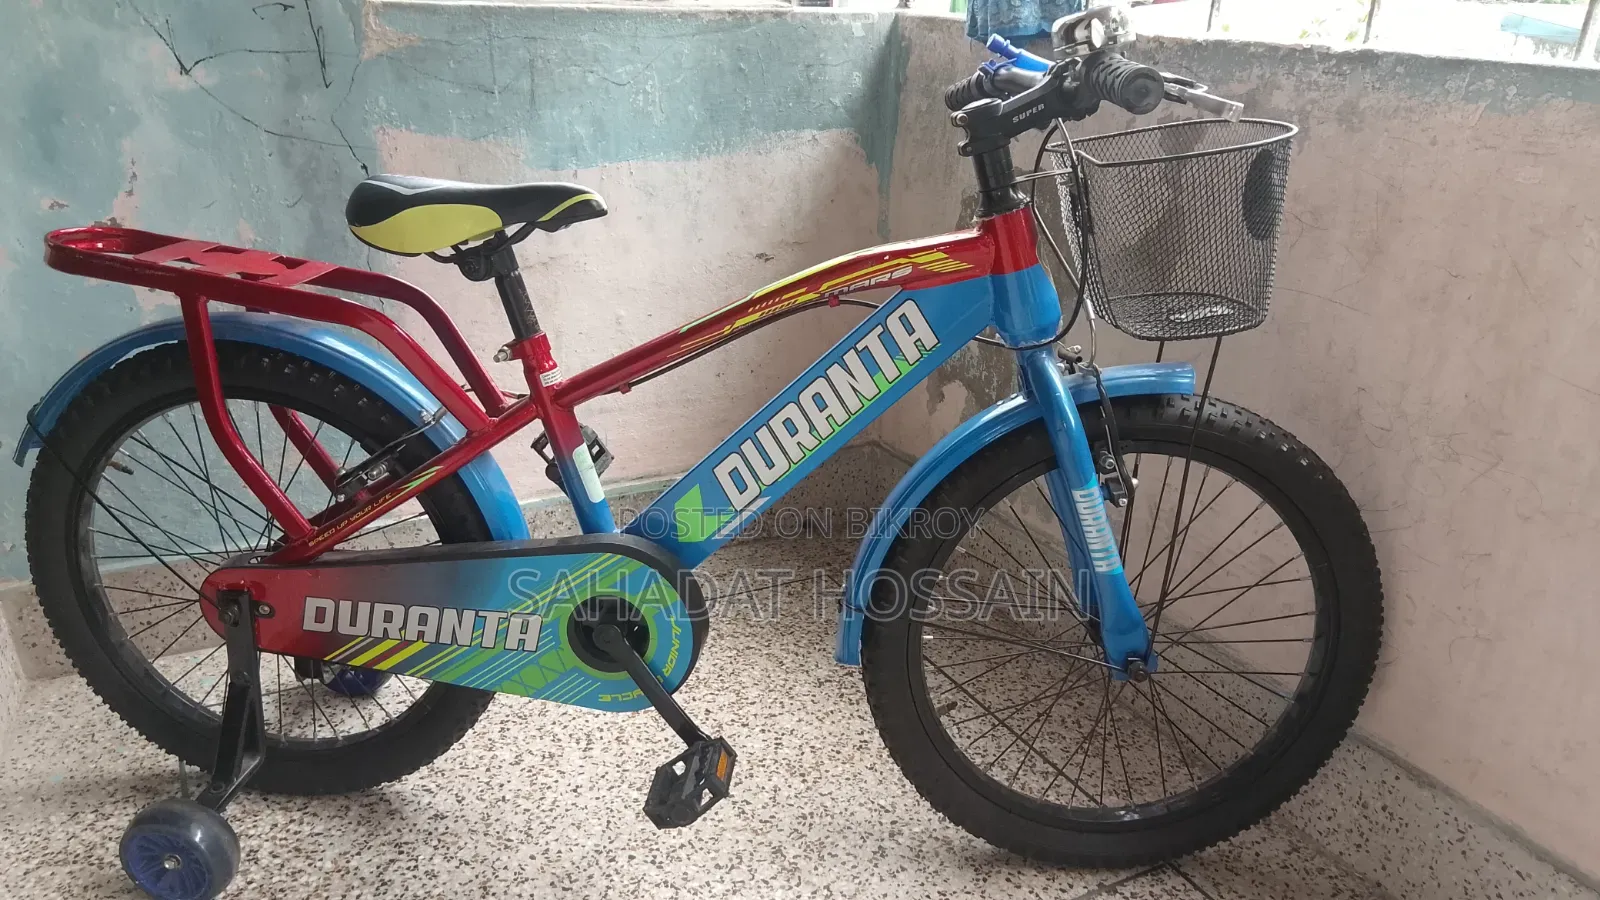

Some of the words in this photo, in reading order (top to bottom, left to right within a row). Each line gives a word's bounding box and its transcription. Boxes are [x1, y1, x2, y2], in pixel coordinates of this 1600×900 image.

[1012, 103, 1045, 123] SUPER
[712, 299, 940, 513] DURANTA
[308, 528, 336, 547] SPEED
[337, 519, 348, 530] UP
[350, 505, 372, 522] YOUR
[373, 492, 393, 508] LIFE
[1072, 486, 1122, 572] DURANTA
[302, 596, 543, 652] DURANTA
[662, 616, 682, 677] JUNIOR
